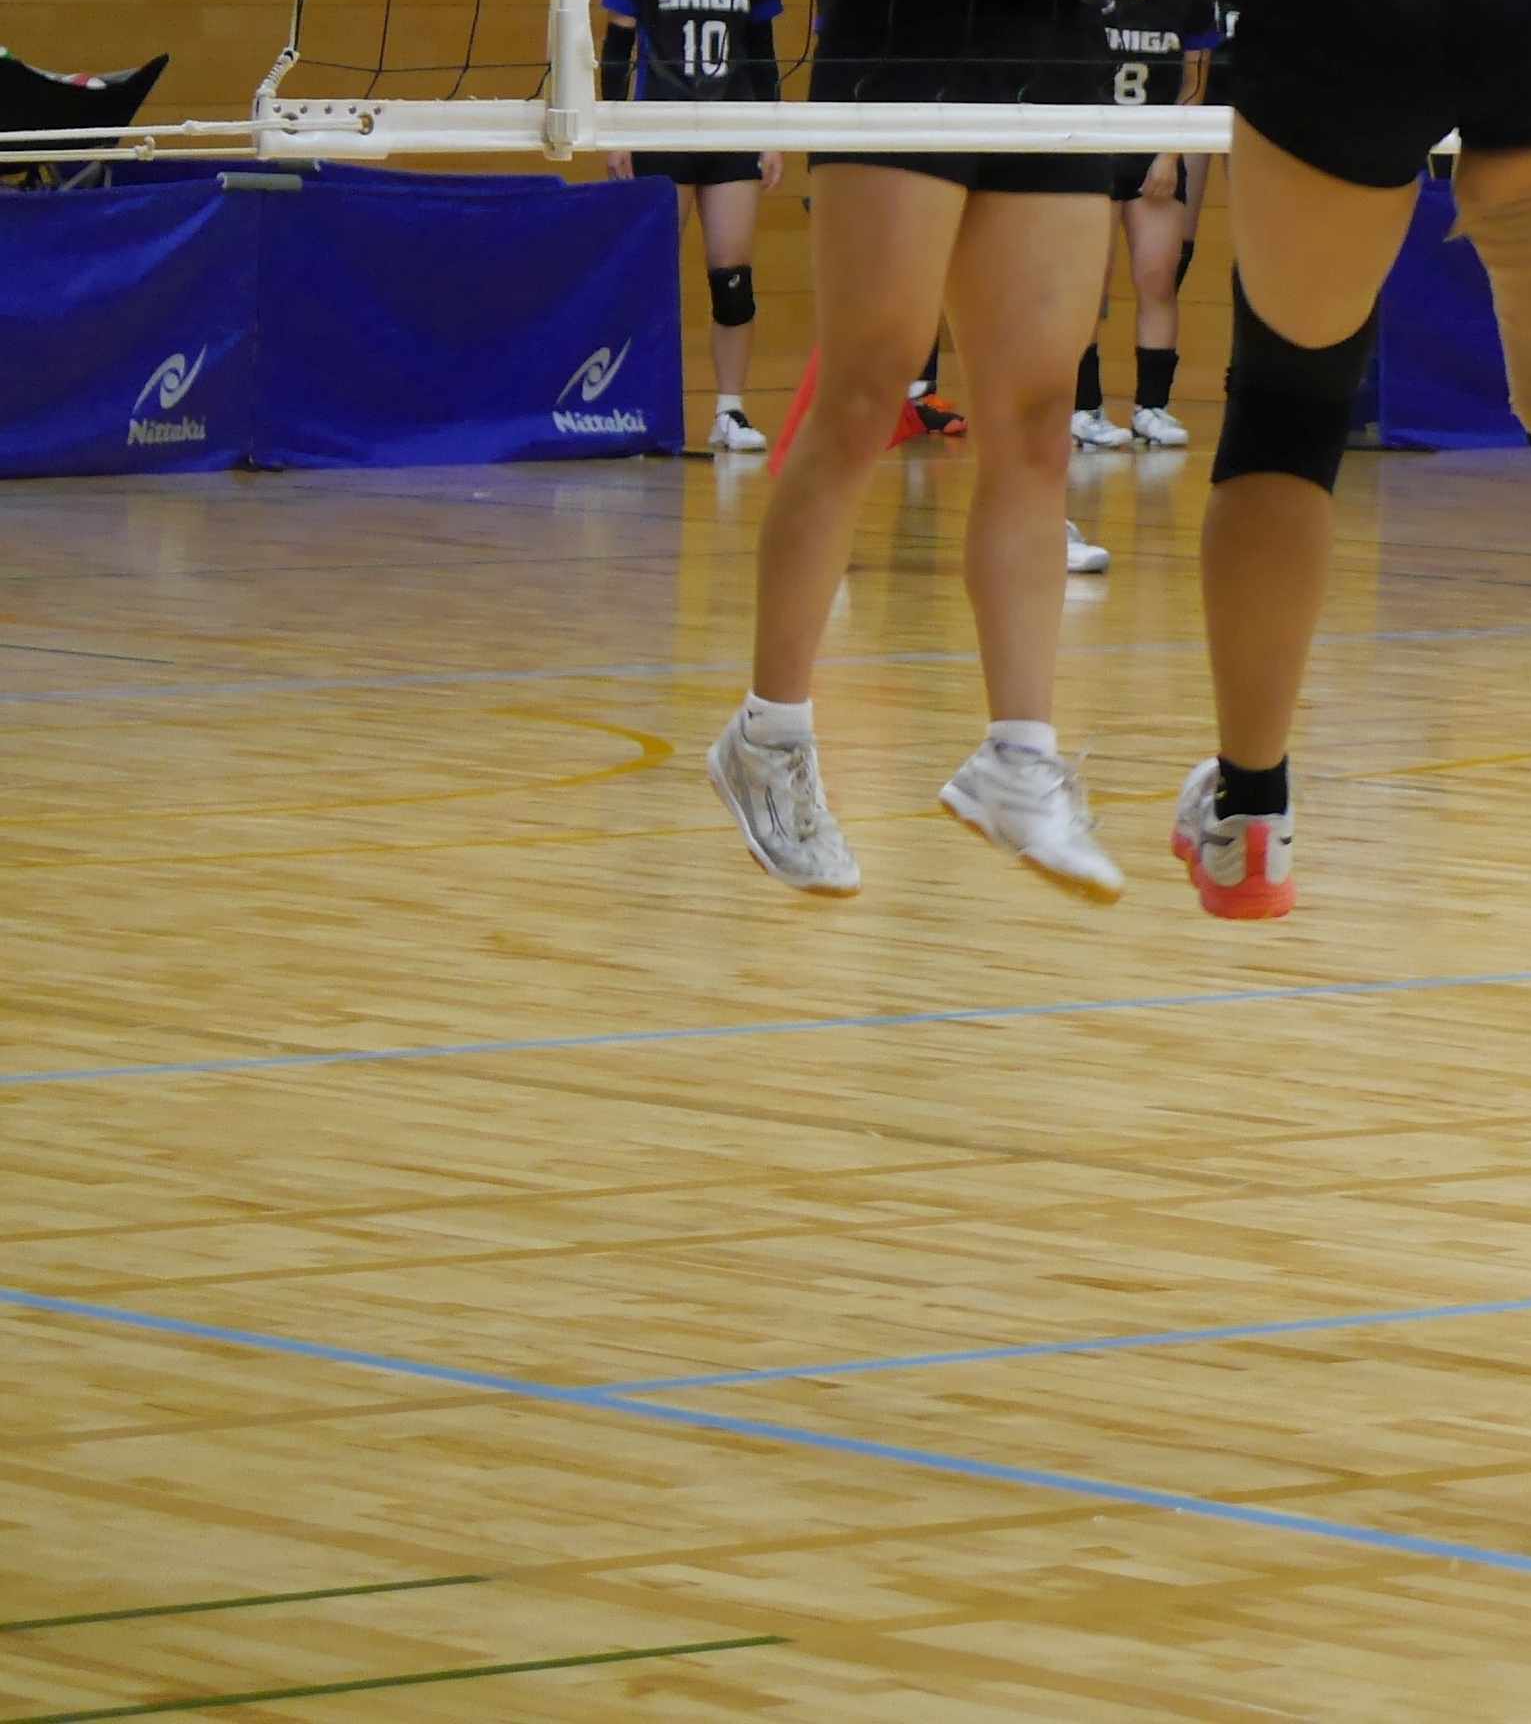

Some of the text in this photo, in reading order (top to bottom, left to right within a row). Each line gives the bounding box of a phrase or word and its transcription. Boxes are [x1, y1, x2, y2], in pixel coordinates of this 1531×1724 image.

[683, 19, 729, 77] 10
[1105, 27, 1182, 53] HIGA
[1114, 62, 1149, 105] 8
